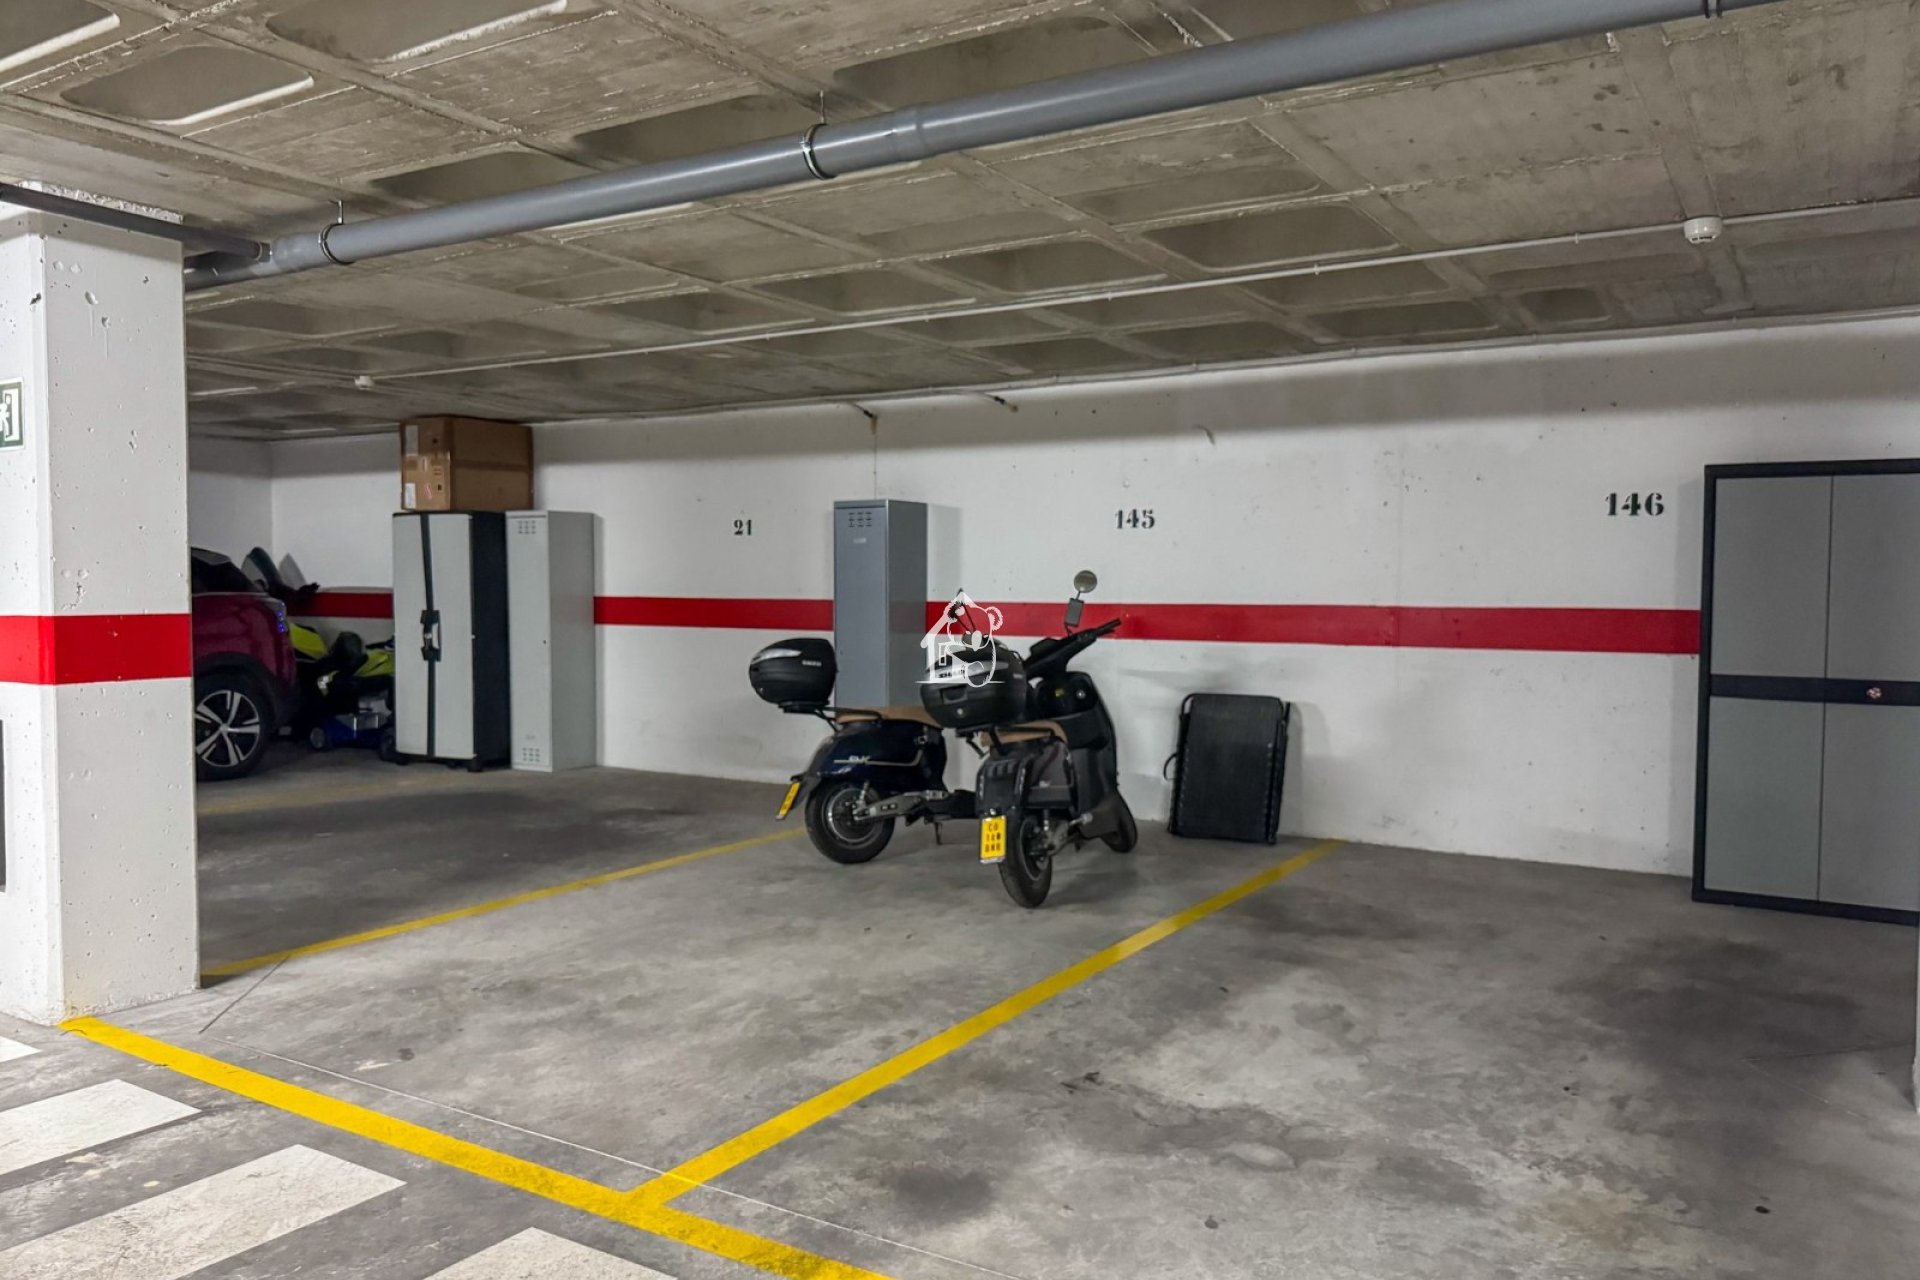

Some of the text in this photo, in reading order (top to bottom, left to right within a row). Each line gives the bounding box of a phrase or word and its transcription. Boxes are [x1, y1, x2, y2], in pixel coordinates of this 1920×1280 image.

[1604, 492, 1665, 517] 146
[733, 518, 752, 536] 21
[1114, 508, 1156, 530] 145
